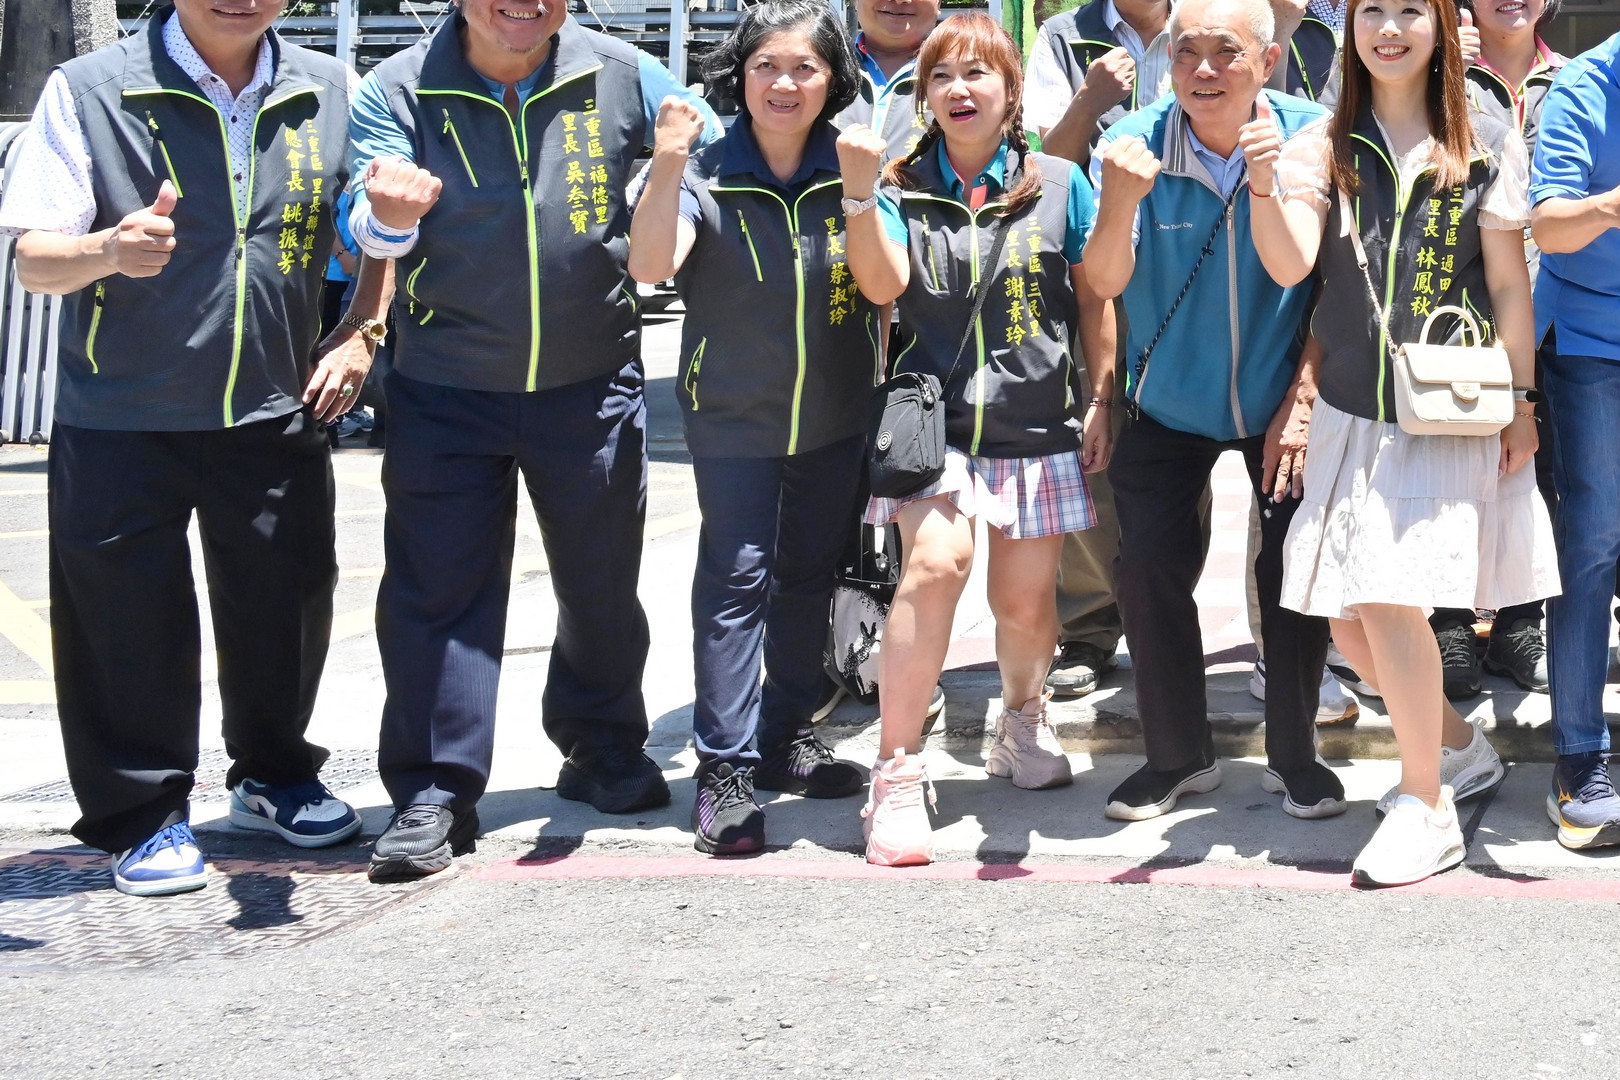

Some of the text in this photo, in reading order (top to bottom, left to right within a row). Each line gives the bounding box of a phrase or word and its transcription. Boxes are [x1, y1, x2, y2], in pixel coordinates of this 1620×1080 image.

[561, 113, 582, 154] 里長
[584, 98, 609, 225] 三重區 福德里
[277, 201, 304, 275] 姚振芳
[1004, 229, 1023, 269] 里長
[1410, 198, 1443, 319] 里長 林鳳秋
[1444, 187, 1465, 246] 三重區
[823, 216, 849, 326] 里長 蔡淑玲
[1025, 215, 1042, 338] 三重區 三民里
